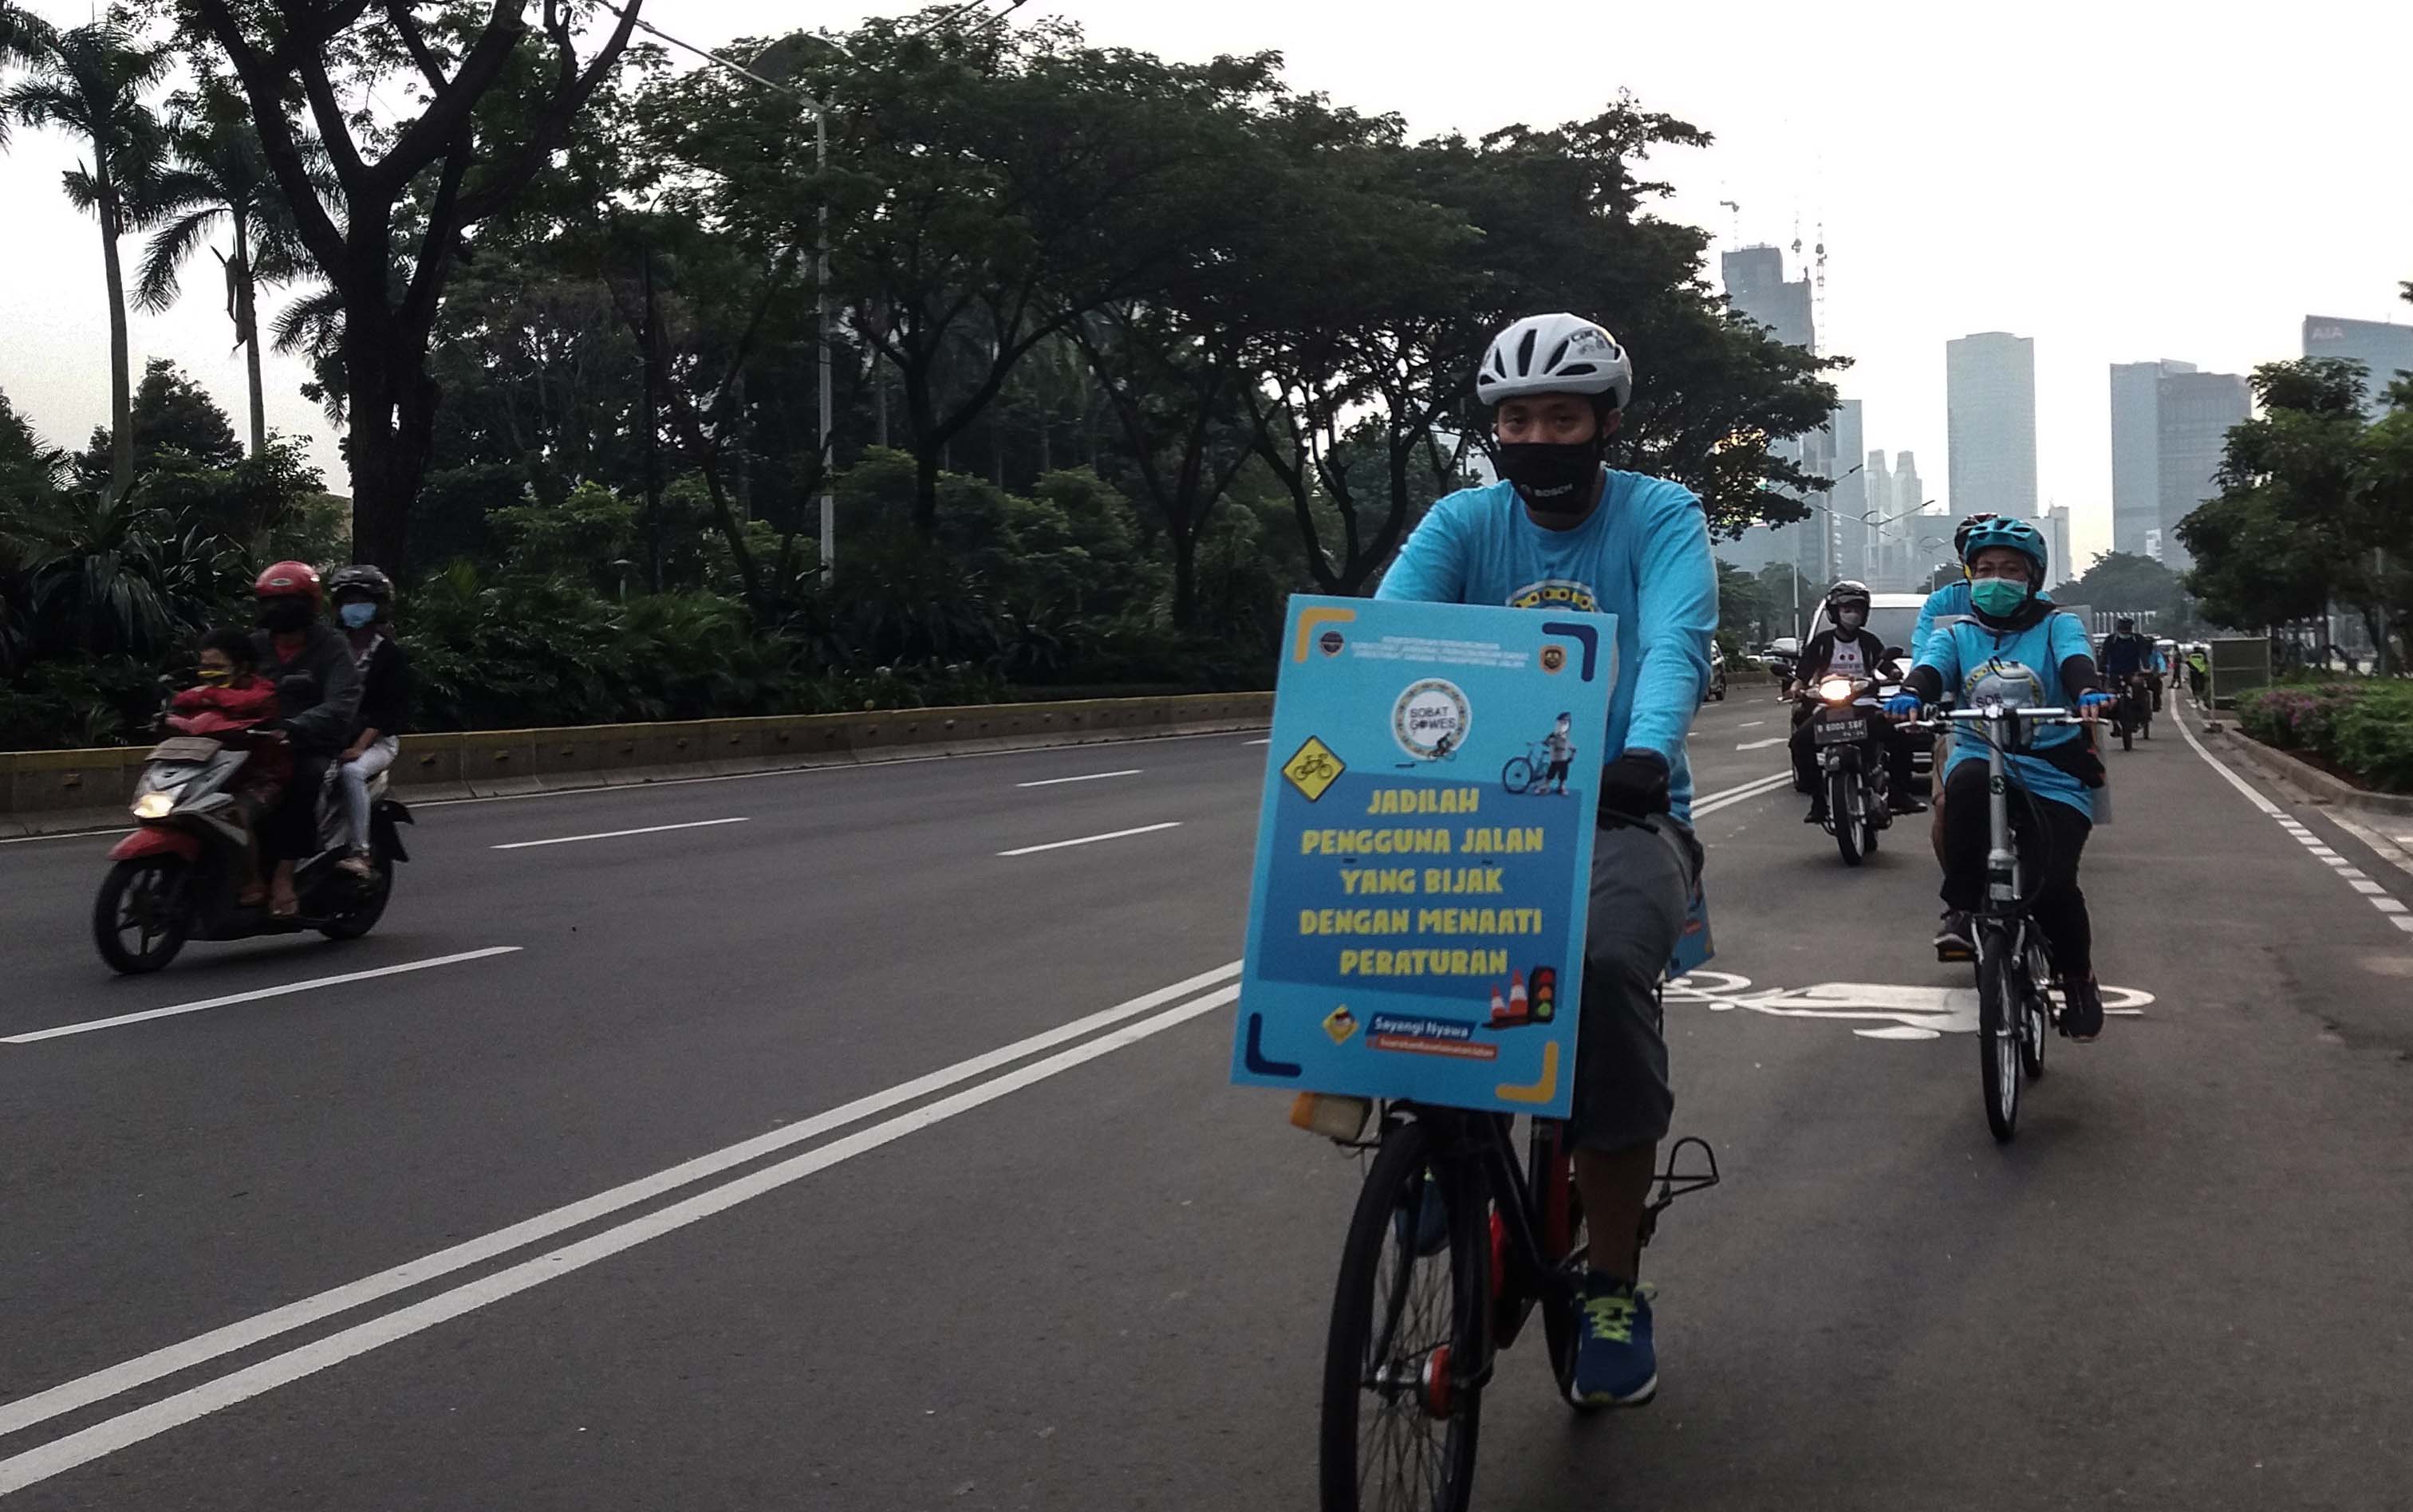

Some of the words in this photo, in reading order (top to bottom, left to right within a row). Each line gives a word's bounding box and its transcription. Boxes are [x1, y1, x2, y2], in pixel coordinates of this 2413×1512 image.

[1410, 706, 1449, 718] SOBAT
[1367, 788, 1480, 814] JADILAH
[1301, 829, 1451, 855] PENGGUNA
[1460, 827, 1544, 853] JALAN
[1340, 868, 1416, 894] YANG
[1424, 868, 1503, 893] BIJAK
[1299, 909, 1410, 935] DENGAN
[1417, 908, 1542, 934] MENAATI
[1339, 949, 1508, 975] PERATURAN
[1374, 1016, 1425, 1036] Sayangi
[1426, 1021, 1469, 1038] Nyawa
